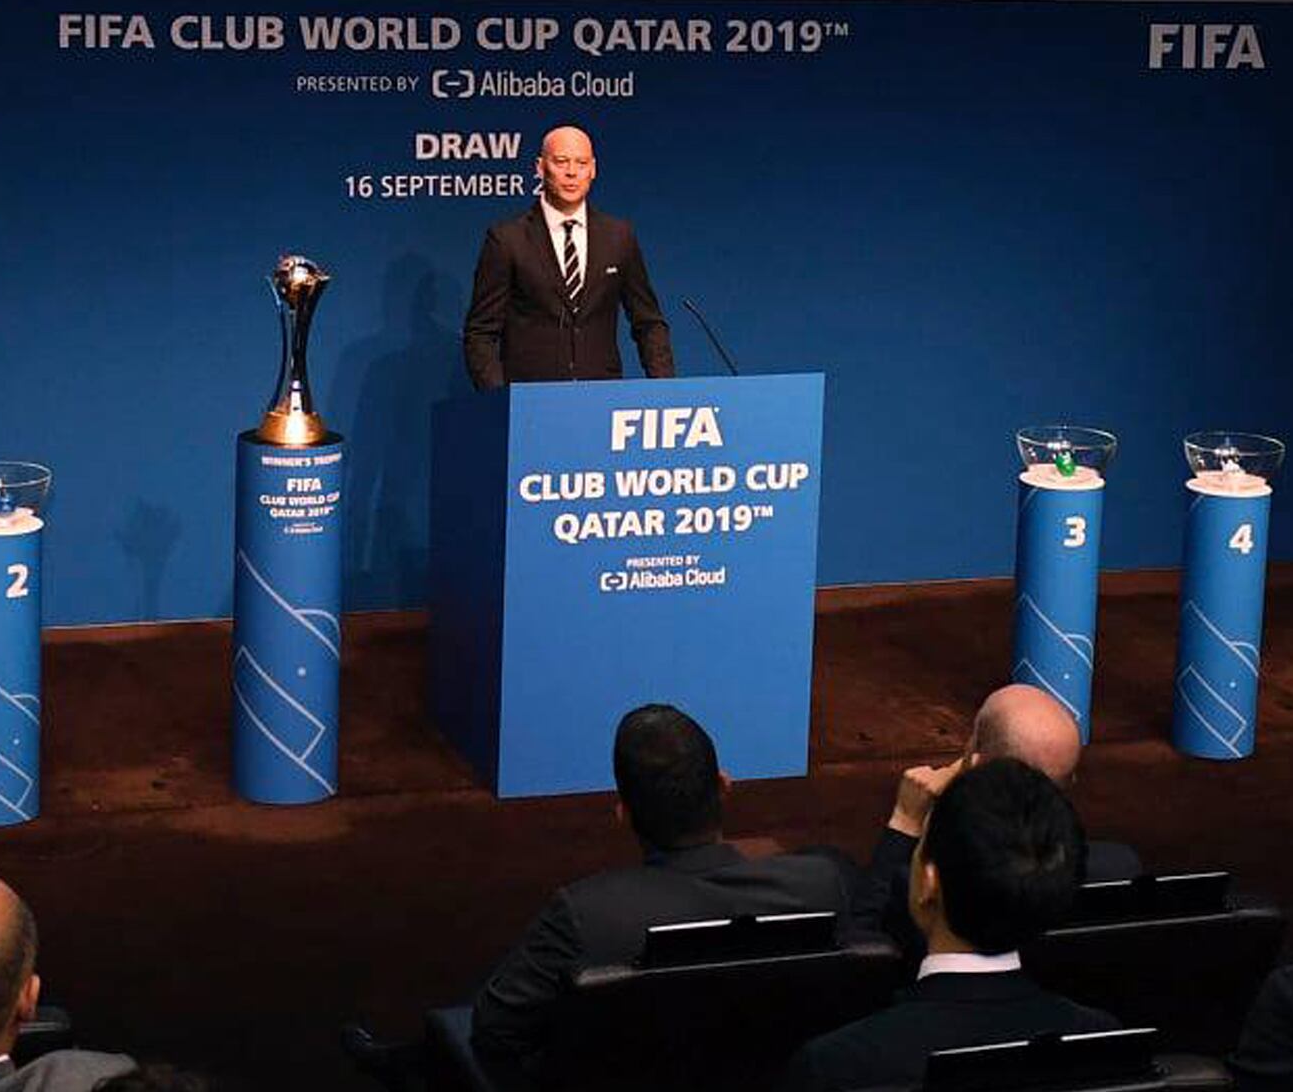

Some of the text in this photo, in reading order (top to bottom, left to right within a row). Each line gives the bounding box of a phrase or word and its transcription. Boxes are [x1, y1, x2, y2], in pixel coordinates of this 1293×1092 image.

[60, 15, 154, 49] FIFA
[171, 15, 284, 50] CLUB
[301, 17, 461, 51] WORLD
[476, 18, 559, 52] CUP
[573, 19, 711, 56] QATAR
[1149, 24, 1265, 69] FIFA
[297, 71, 633, 96] PRESENTED BY Alibaba Cloud
[416, 134, 521, 159] DRAW
[346, 177, 373, 197] 16
[380, 177, 523, 197] SEPTEMBER
[611, 407, 723, 450] FIFA
[287, 478, 322, 491] FIFA
[520, 463, 808, 502] CLUB WORLD CUP
[554, 509, 664, 543] QATAR
[1064, 516, 1086, 547] 3
[1229, 524, 1253, 554] 4
[626, 556, 699, 568] PRESENTED BY
[6, 565, 28, 598] 2
[629, 568, 725, 589] Alibaba Cloud
